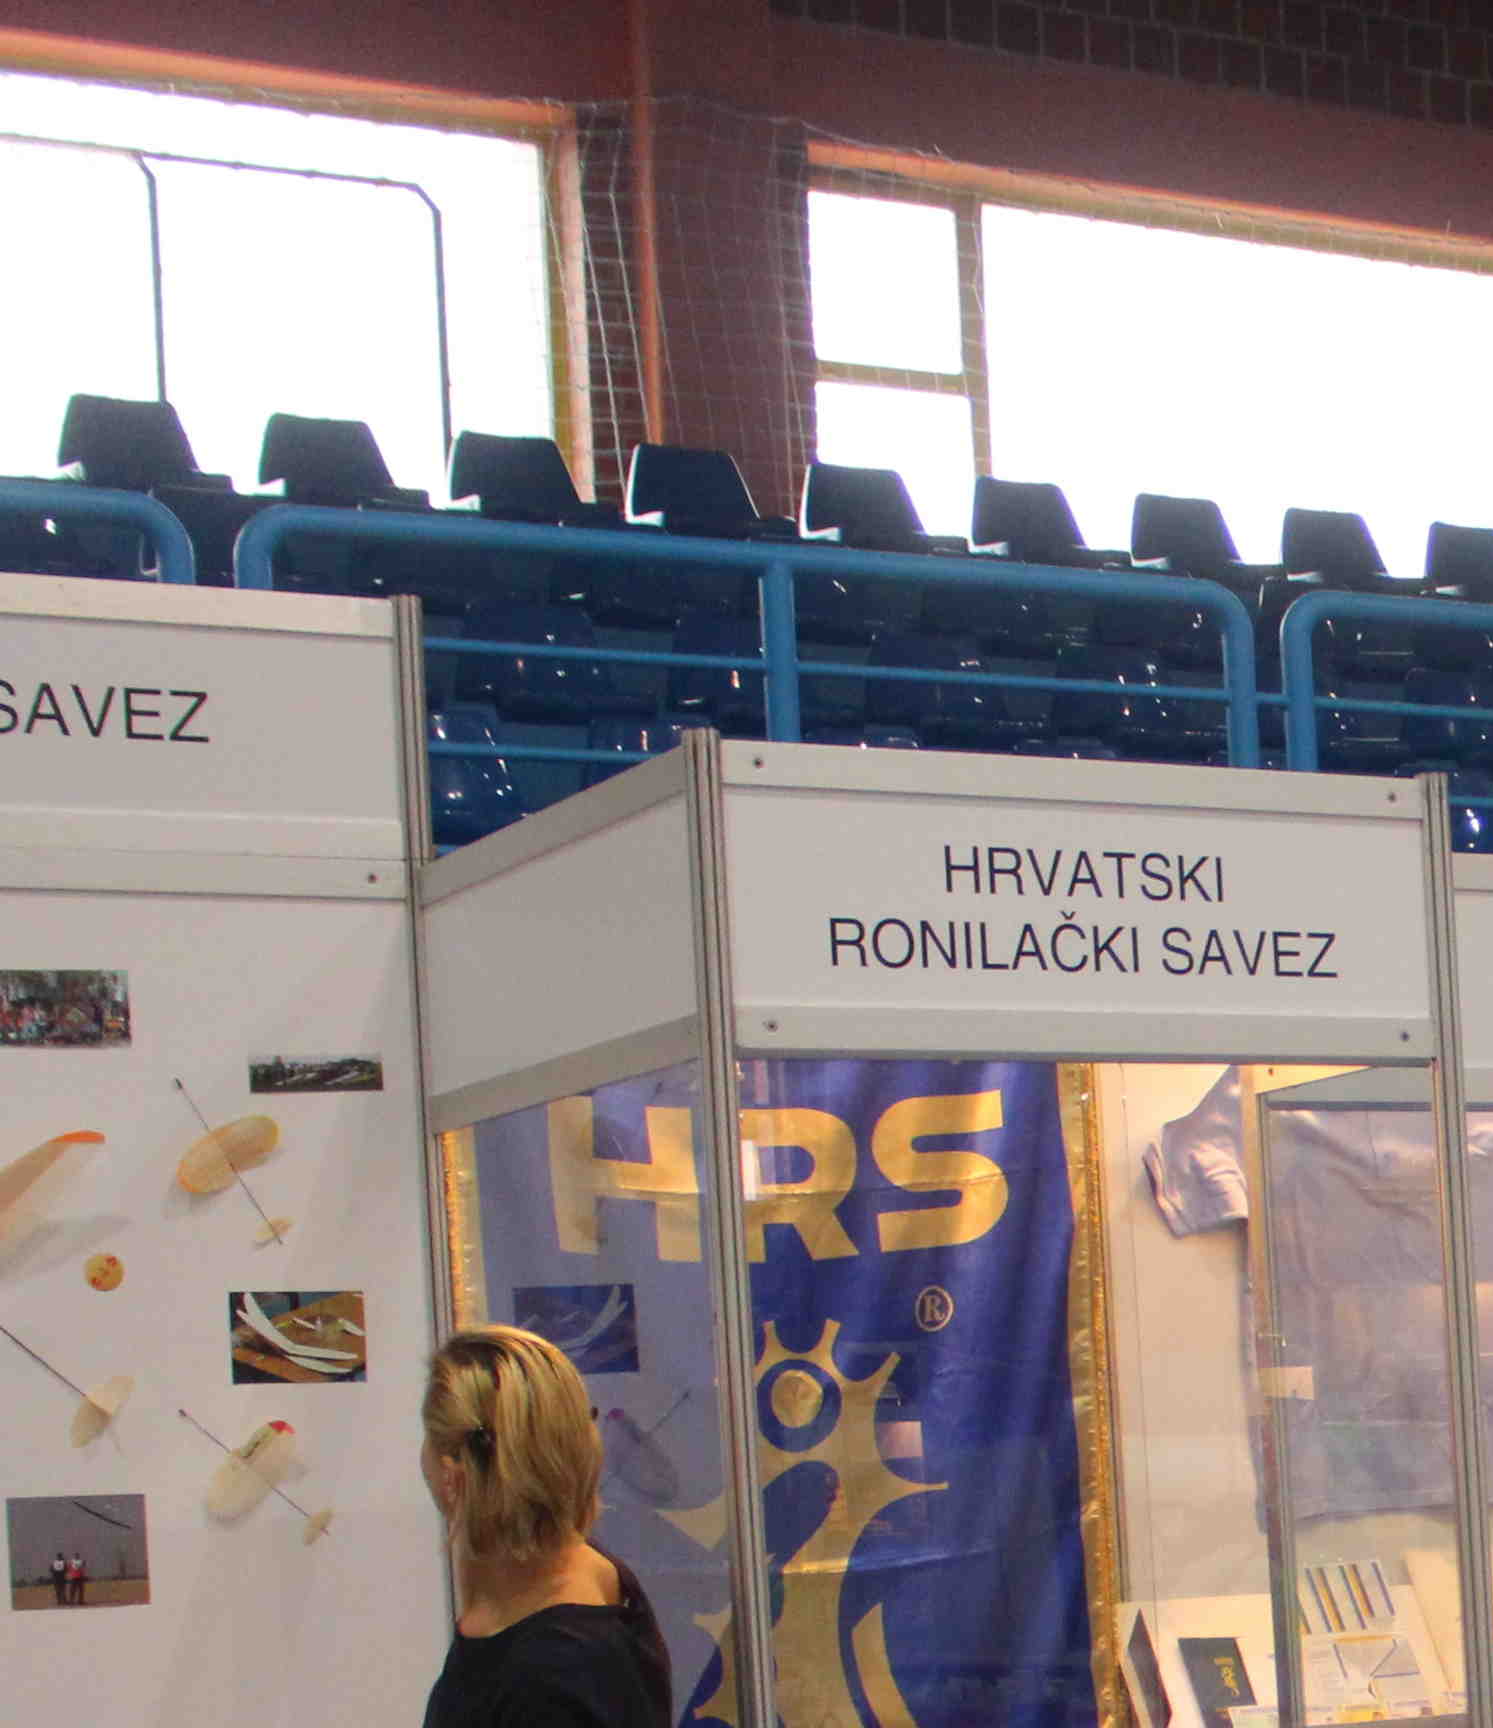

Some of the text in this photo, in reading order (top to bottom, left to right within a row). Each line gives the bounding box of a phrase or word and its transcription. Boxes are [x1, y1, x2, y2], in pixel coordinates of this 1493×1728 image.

[943, 844, 1225, 903] HRVATSKI
[828, 909, 1339, 978] RONILAČKI SAVEZ
[547, 1089, 1009, 1262] HRS
